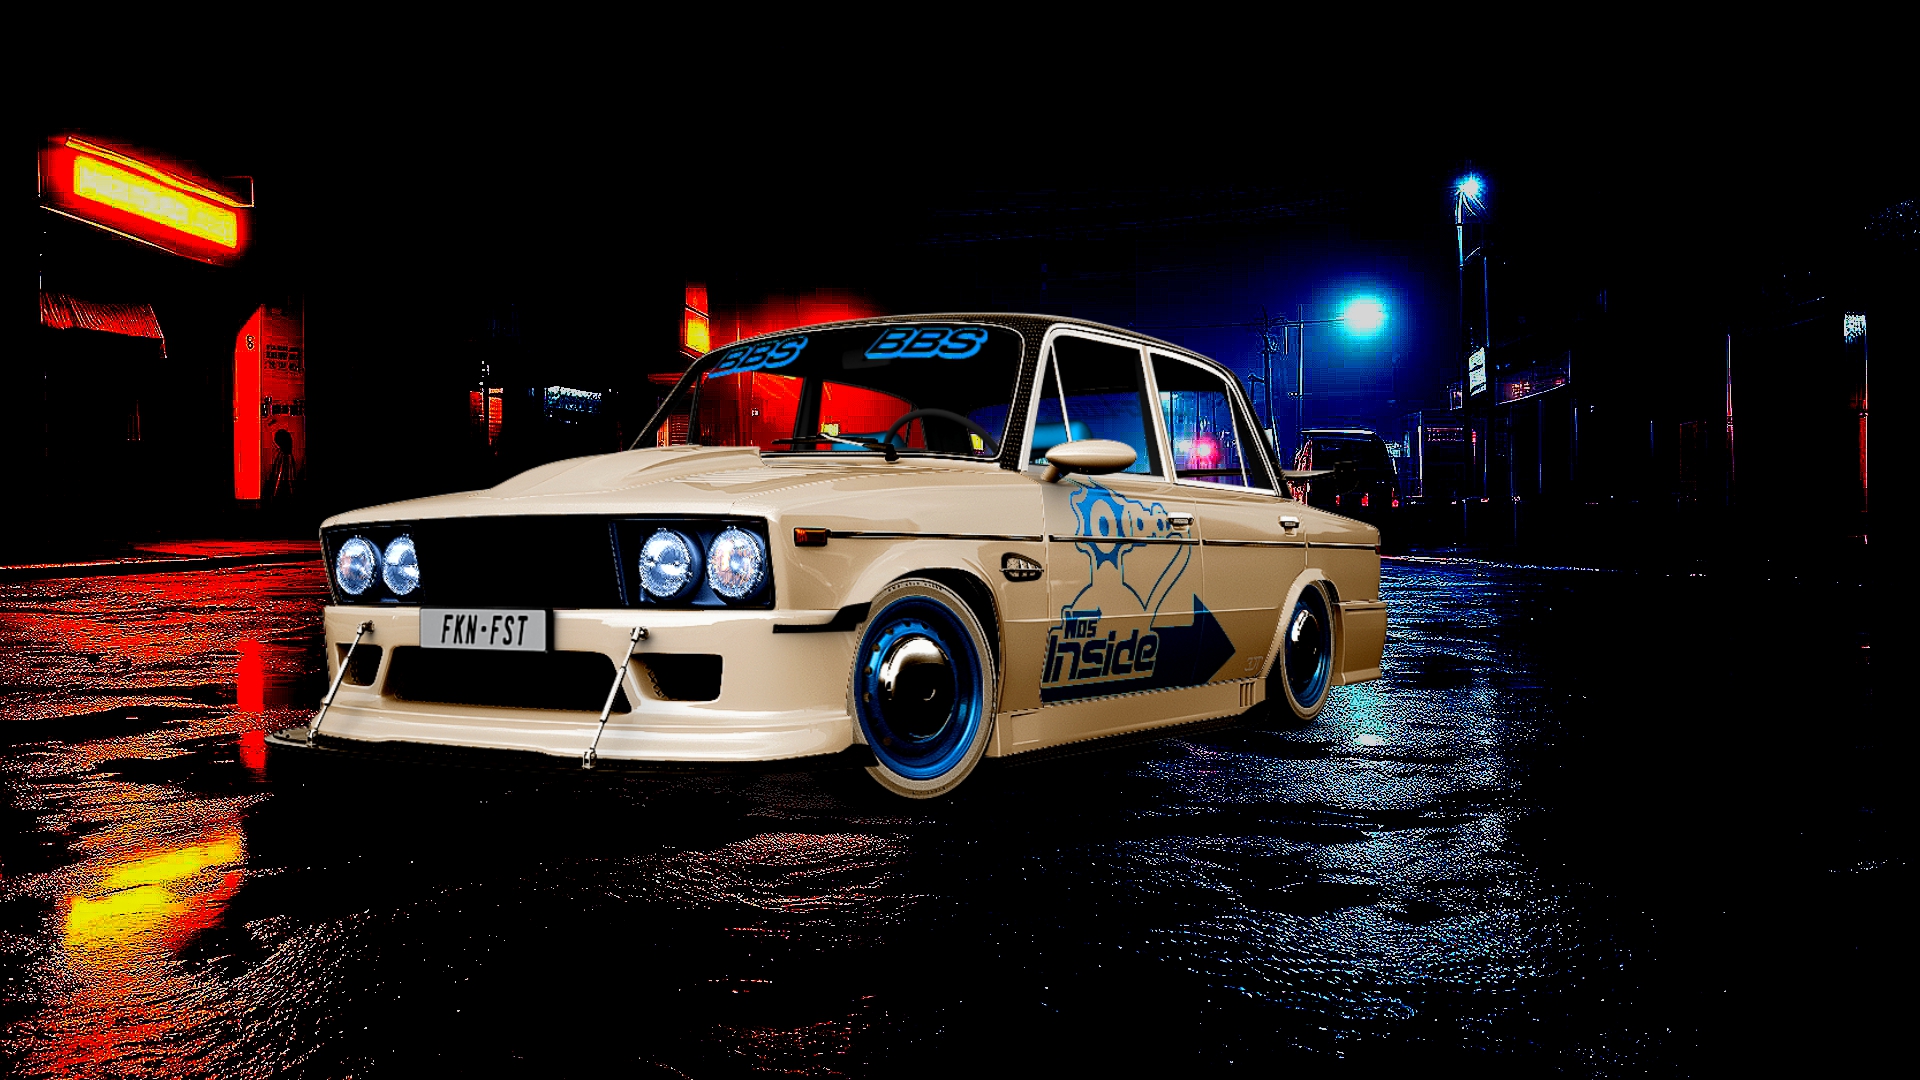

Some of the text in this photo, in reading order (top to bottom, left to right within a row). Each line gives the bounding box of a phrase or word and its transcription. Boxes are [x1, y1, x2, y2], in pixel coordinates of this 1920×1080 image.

[708, 336, 808, 379] BBS
[864, 328, 988, 359] BBS
[1042, 629, 1159, 683] Inside
